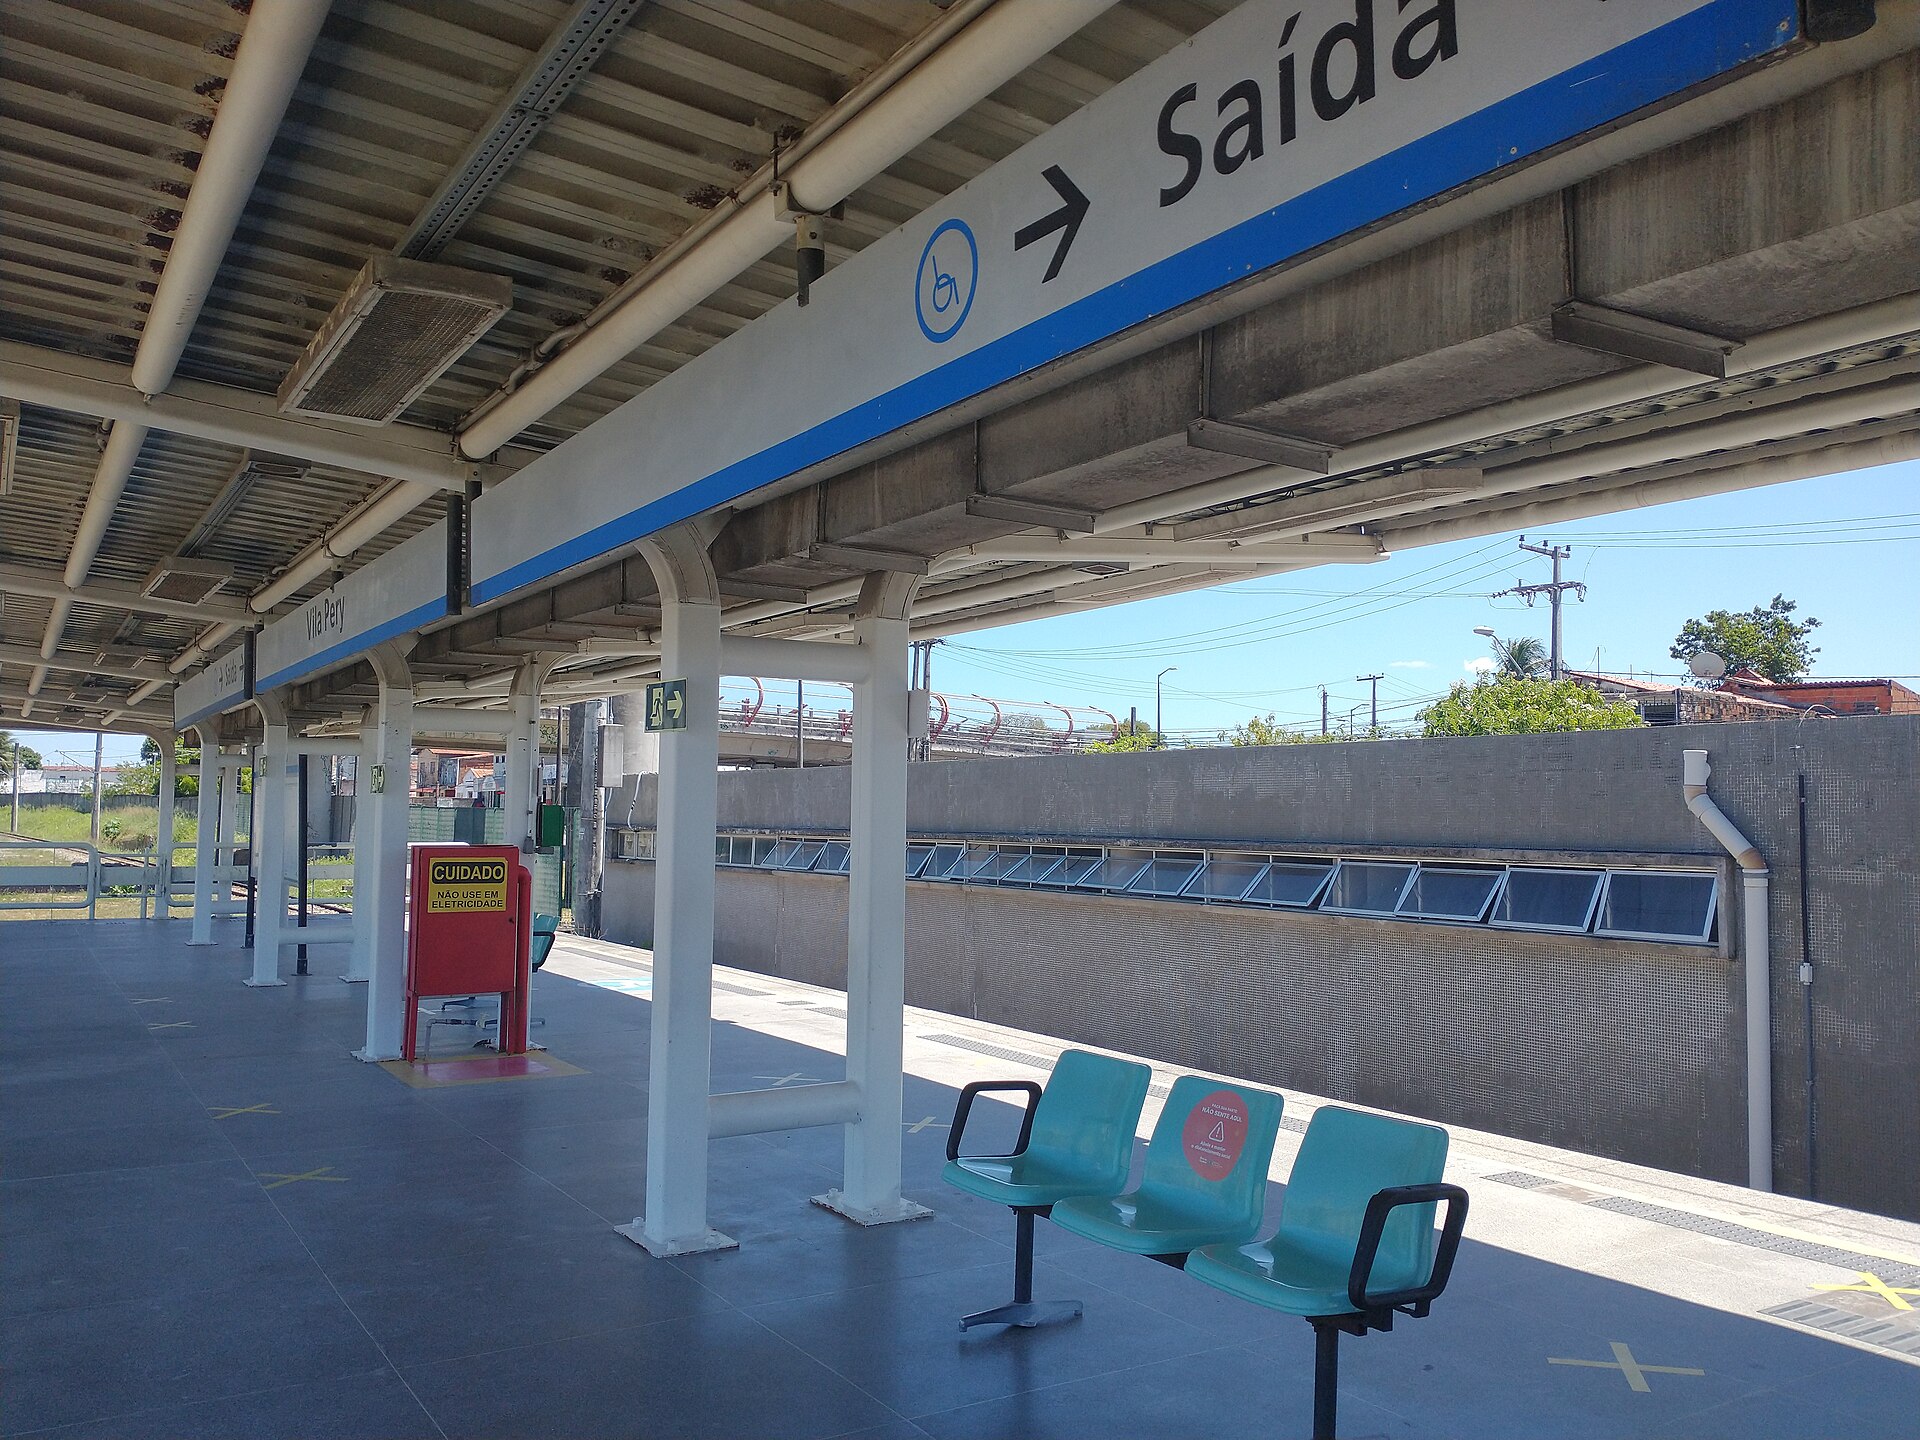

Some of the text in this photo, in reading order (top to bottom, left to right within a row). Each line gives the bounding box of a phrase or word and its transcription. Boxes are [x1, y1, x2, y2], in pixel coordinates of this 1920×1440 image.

[1157, 0, 1459, 208] Saída
[306, 595, 345, 641] Vila Pery
[434, 865, 504, 880] CUIDADO
[437, 890, 499, 899] NÃO USE EM
[432, 900, 503, 908] ELETRICIDADE
[1201, 1106, 1214, 1115] NÃO
[1214, 1111, 1230, 1120] SENTE
